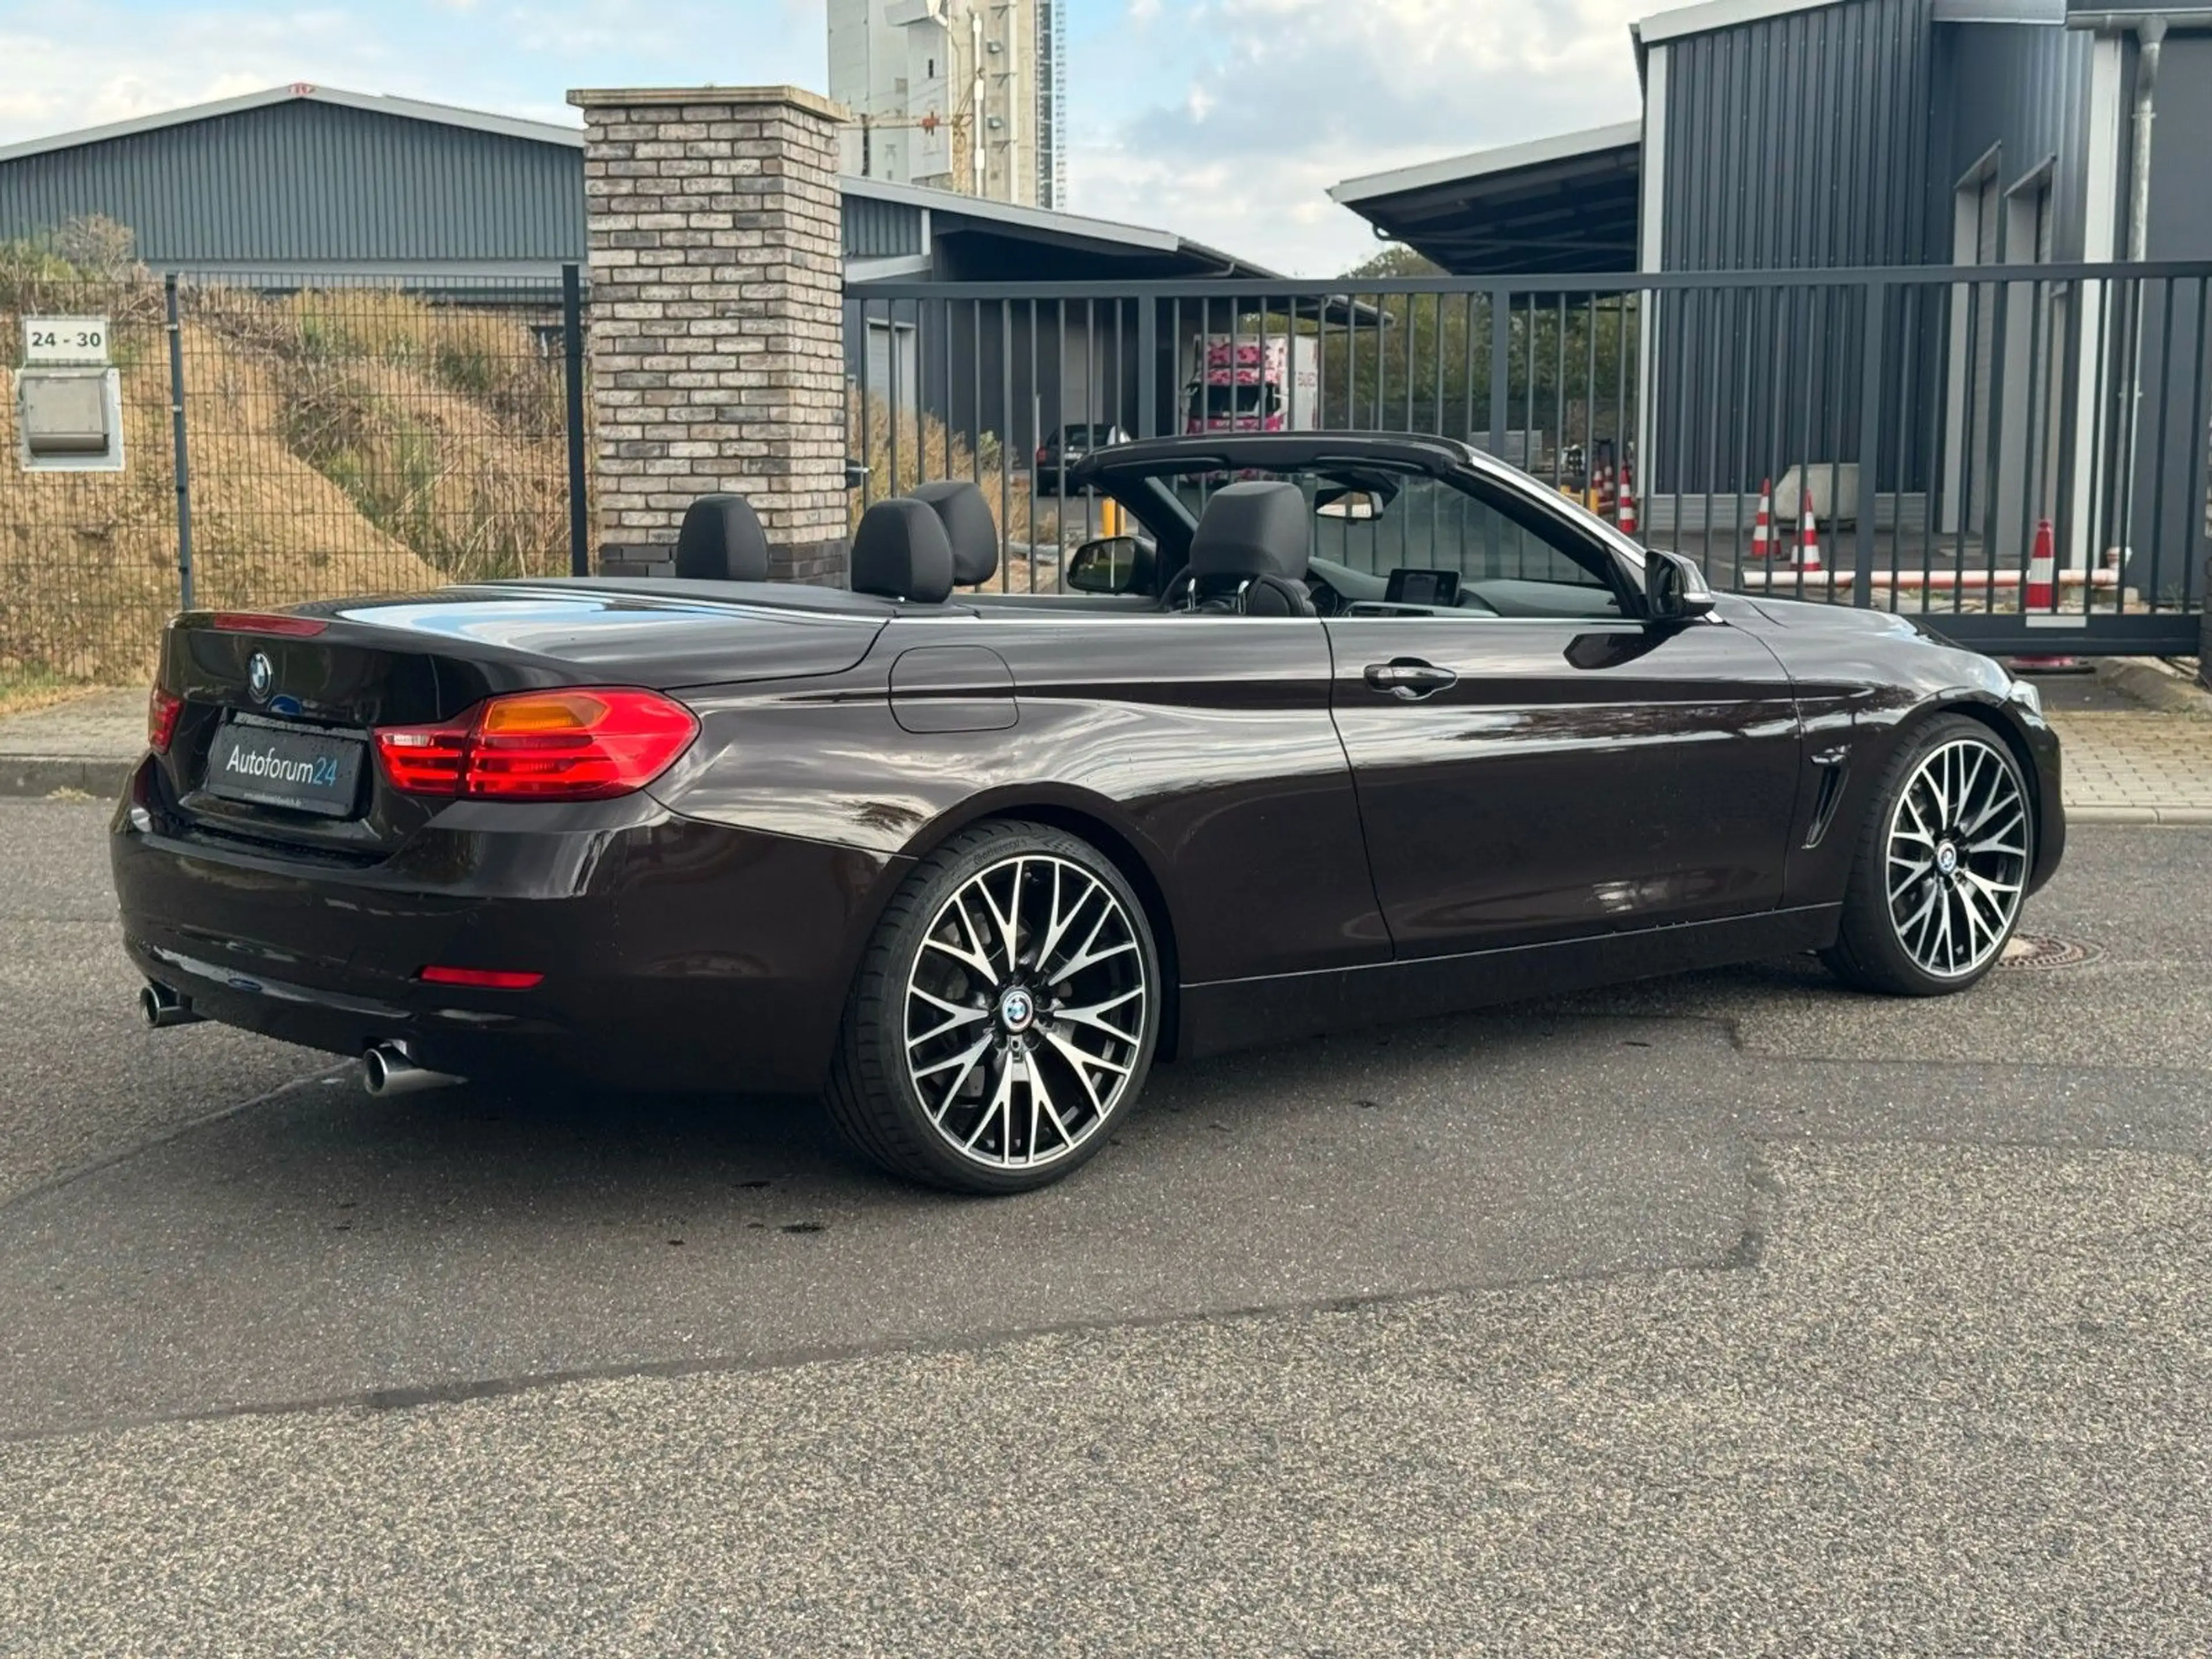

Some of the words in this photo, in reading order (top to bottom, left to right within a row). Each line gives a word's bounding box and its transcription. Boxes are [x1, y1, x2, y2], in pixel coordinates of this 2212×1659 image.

[32, 332, 56, 347] 24
[77, 332, 101, 347] 30
[226, 745, 338, 786] Autoforum24
